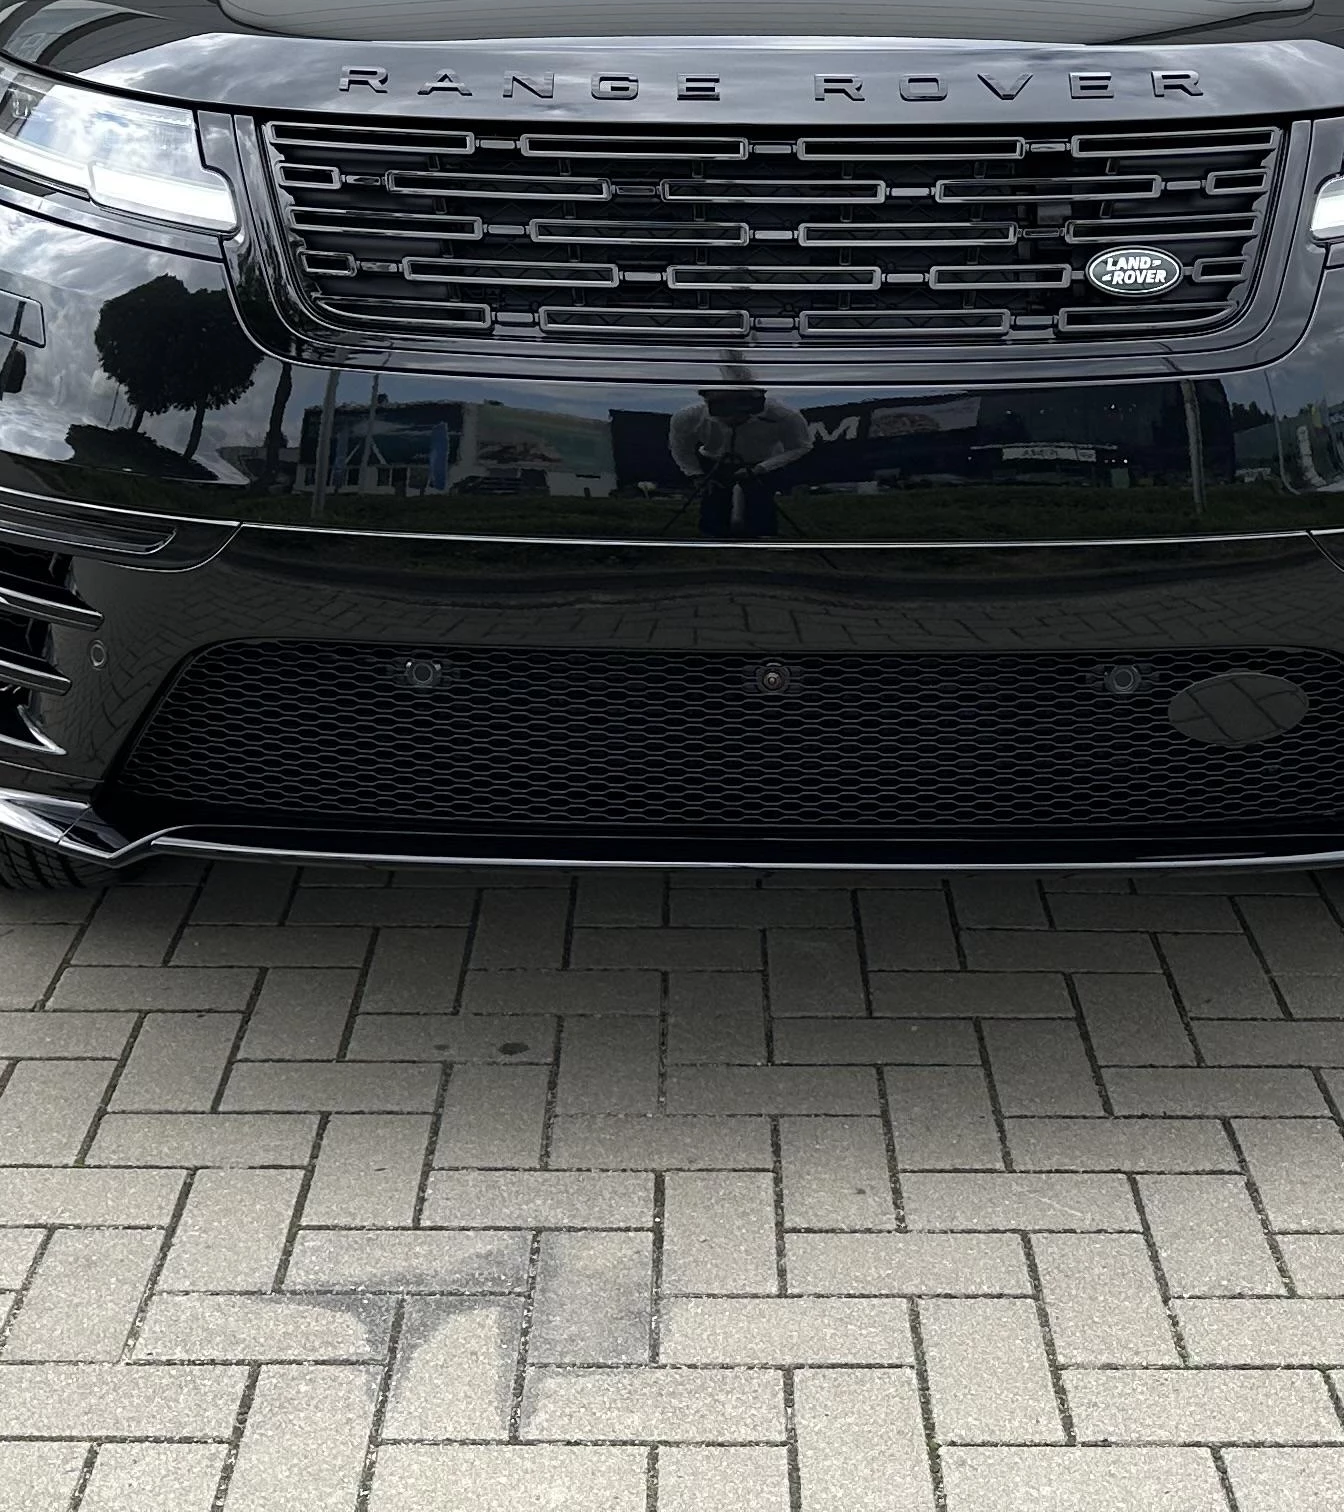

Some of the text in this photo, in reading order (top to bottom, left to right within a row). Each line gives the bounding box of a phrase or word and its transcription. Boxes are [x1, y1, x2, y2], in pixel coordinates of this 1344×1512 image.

[339, 65, 1205, 102] RANGE ROVER
[1106, 256, 1151, 271] LAND
[1110, 270, 1168, 285] ROVER
